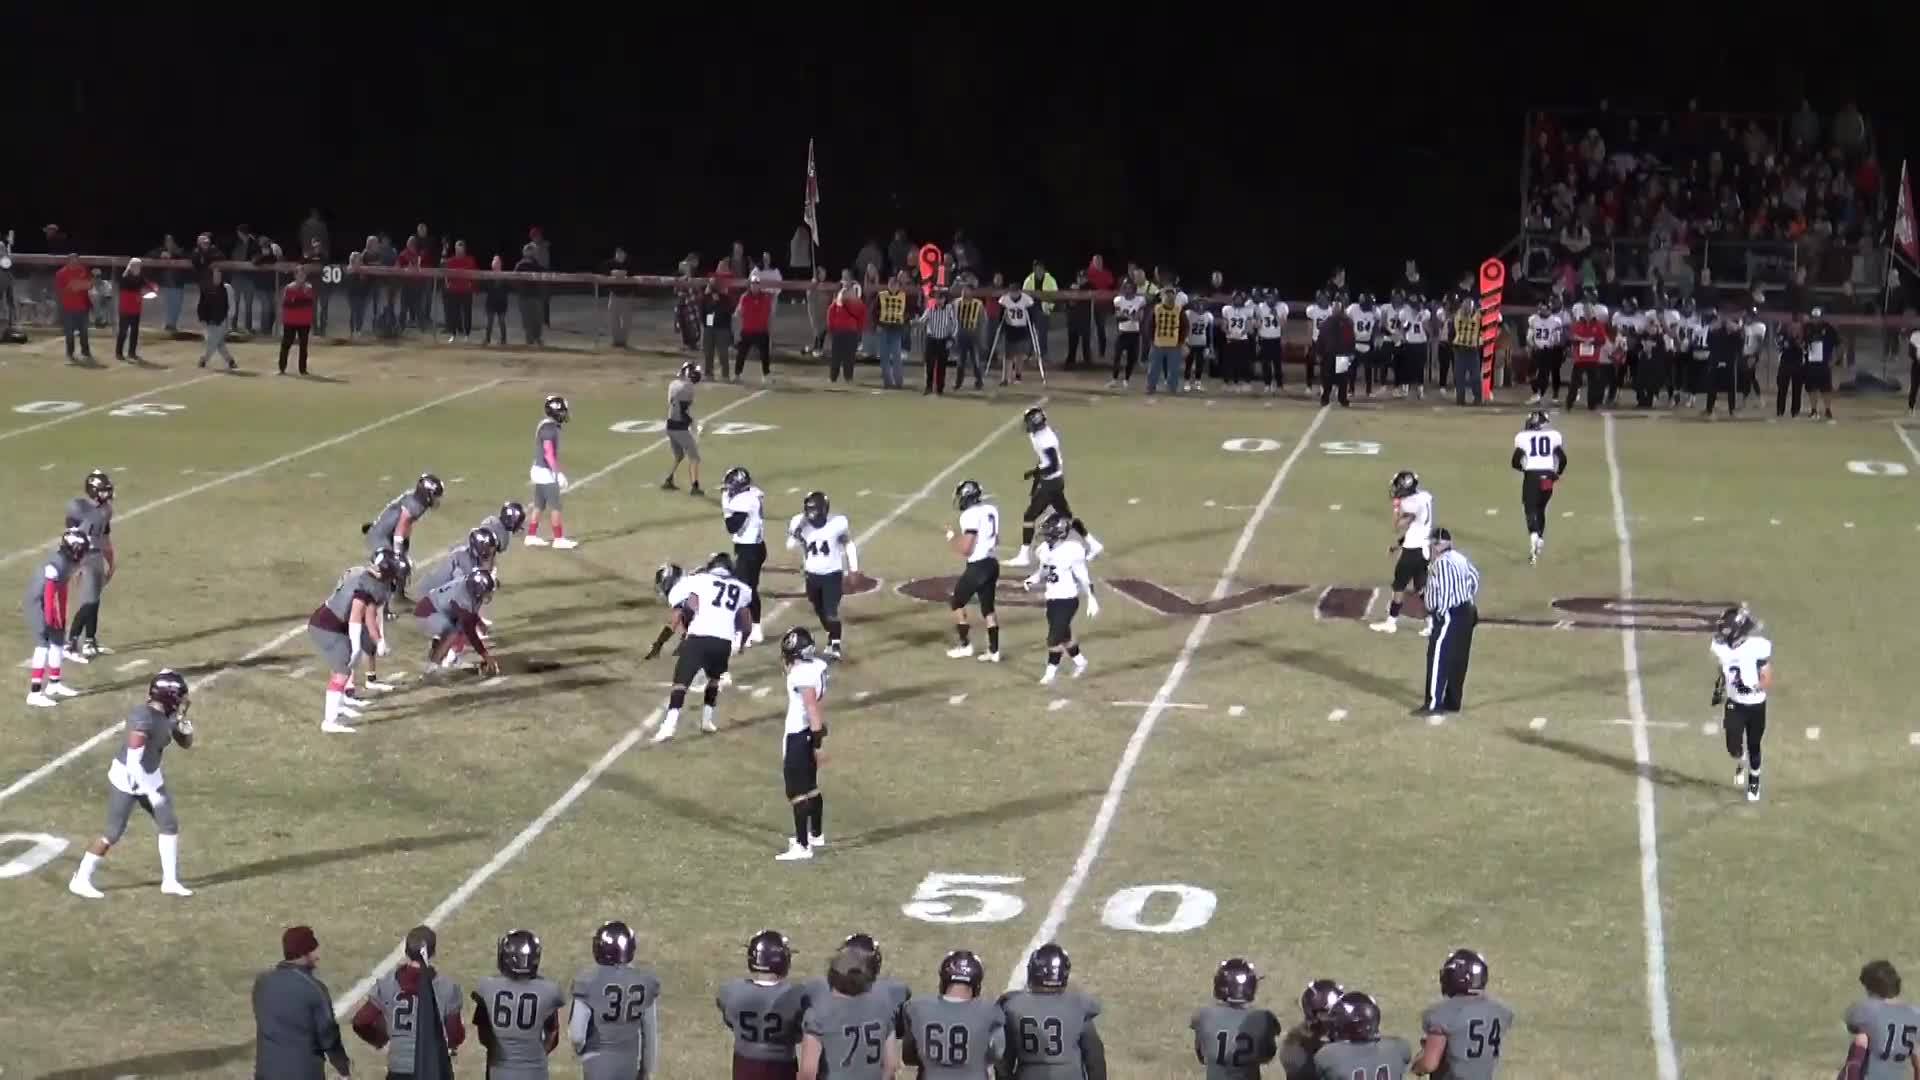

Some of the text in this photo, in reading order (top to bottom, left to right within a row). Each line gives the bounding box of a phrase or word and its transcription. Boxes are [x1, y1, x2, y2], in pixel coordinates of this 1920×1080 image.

[321, 265, 342, 284] 30
[1529, 435, 1551, 457] 10
[711, 580, 740, 612] 79
[490, 990, 539, 1030] 60
[601, 984, 646, 1023] 32
[738, 1011, 784, 1045] 52
[840, 1022, 882, 1068] 75
[923, 1023, 970, 1066] 68
[1018, 1016, 1064, 1058] 63
[1466, 1017, 1502, 1059] 54
[1880, 1022, 1918, 1062] 15
[1215, 1030, 1254, 1068] 12
